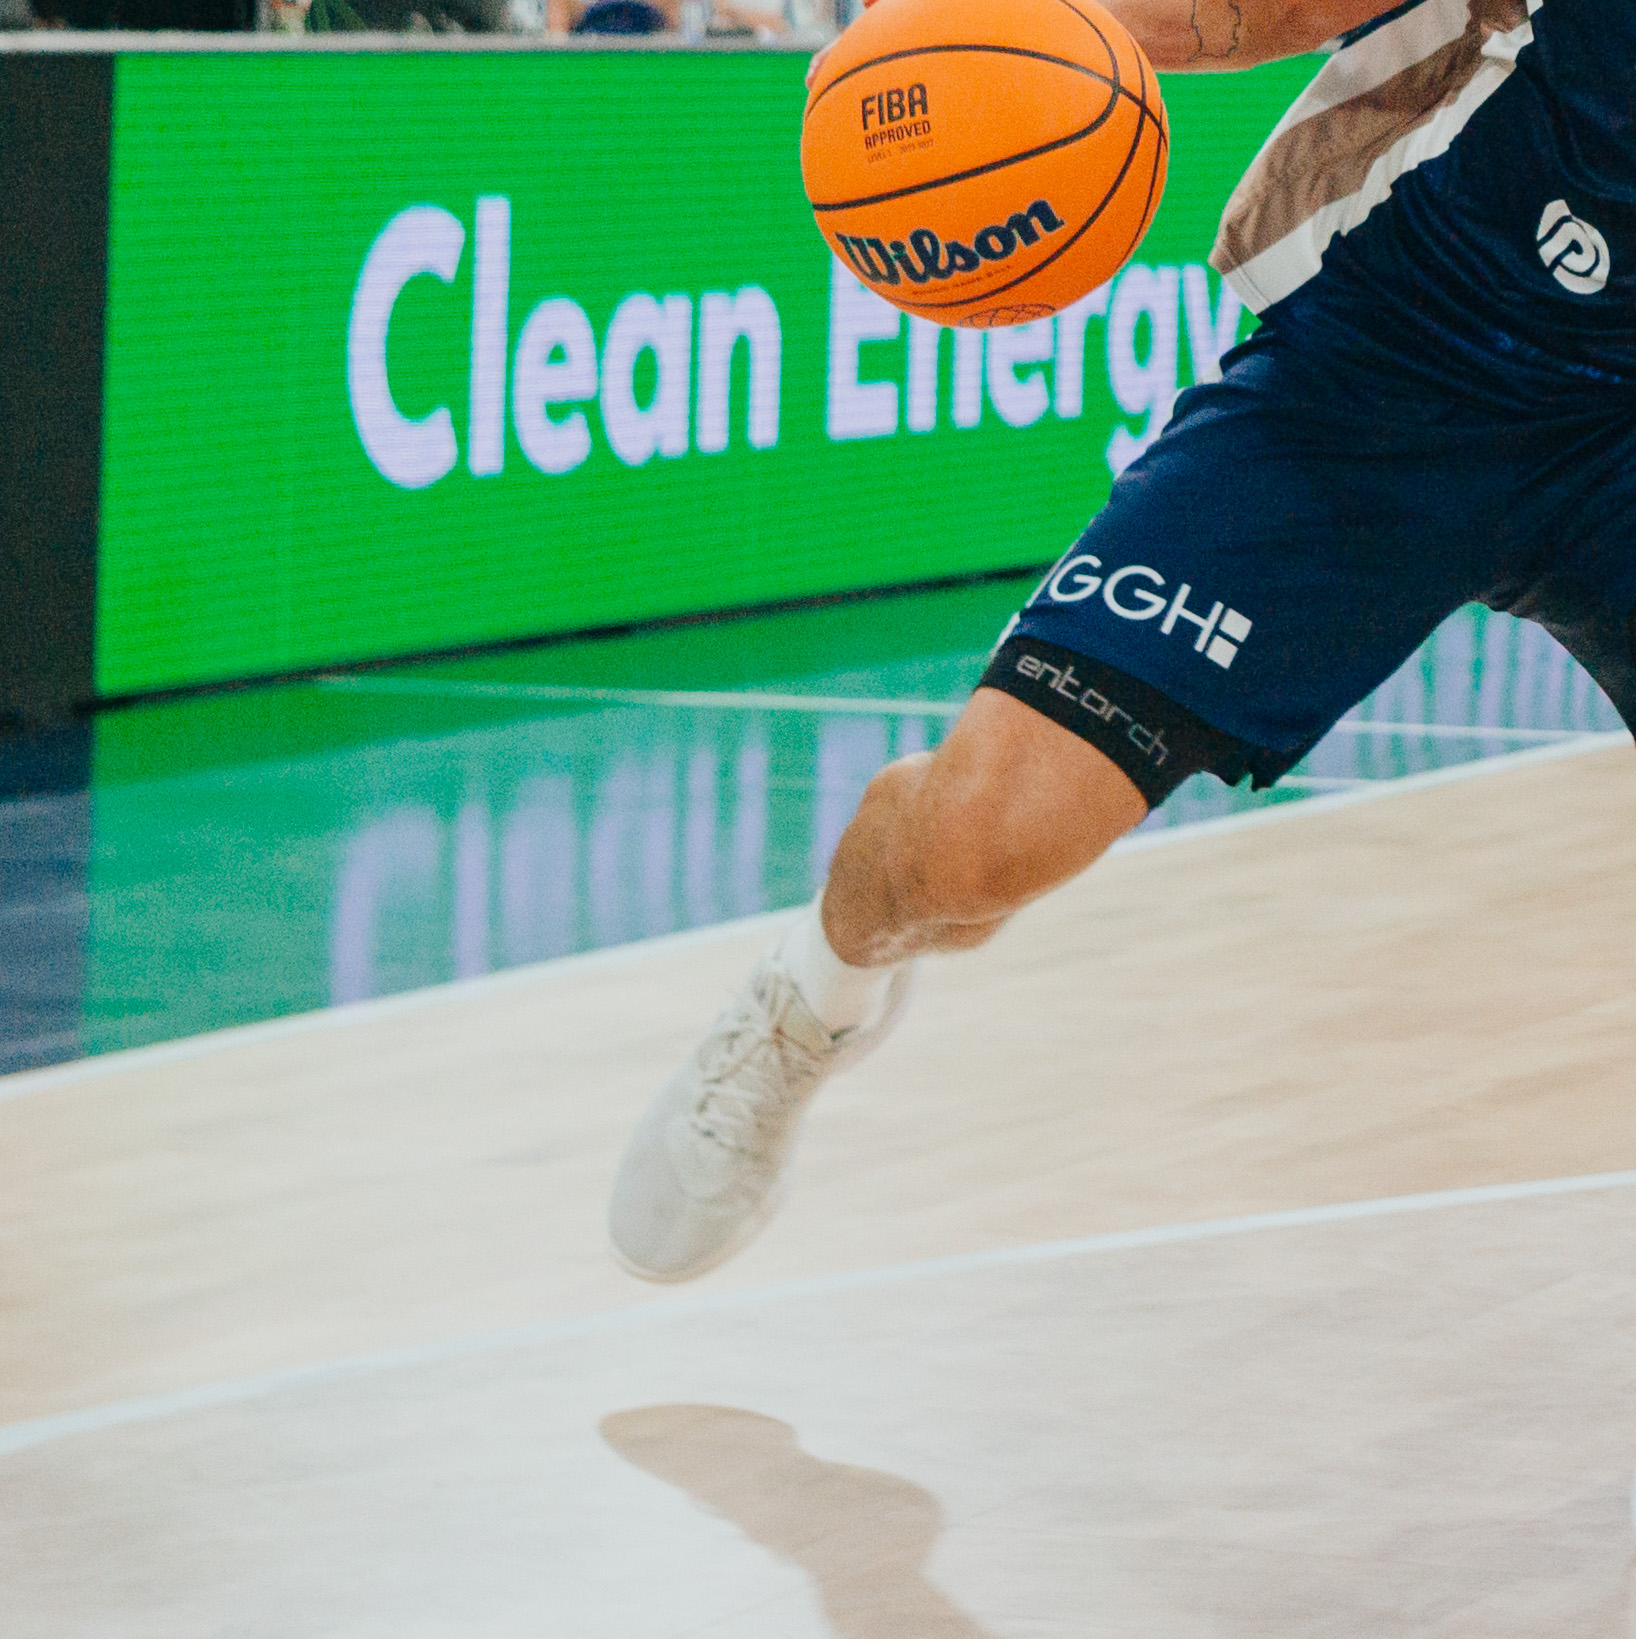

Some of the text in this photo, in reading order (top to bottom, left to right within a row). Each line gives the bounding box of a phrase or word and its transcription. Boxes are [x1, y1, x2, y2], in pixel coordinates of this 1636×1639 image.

[861, 82, 928, 131] FIBA
[864, 120, 931, 151] APPROVED
[834, 199, 1065, 286] Wilson
[346, 194, 783, 491] Clean
[1049, 554, 1224, 653] GGH
